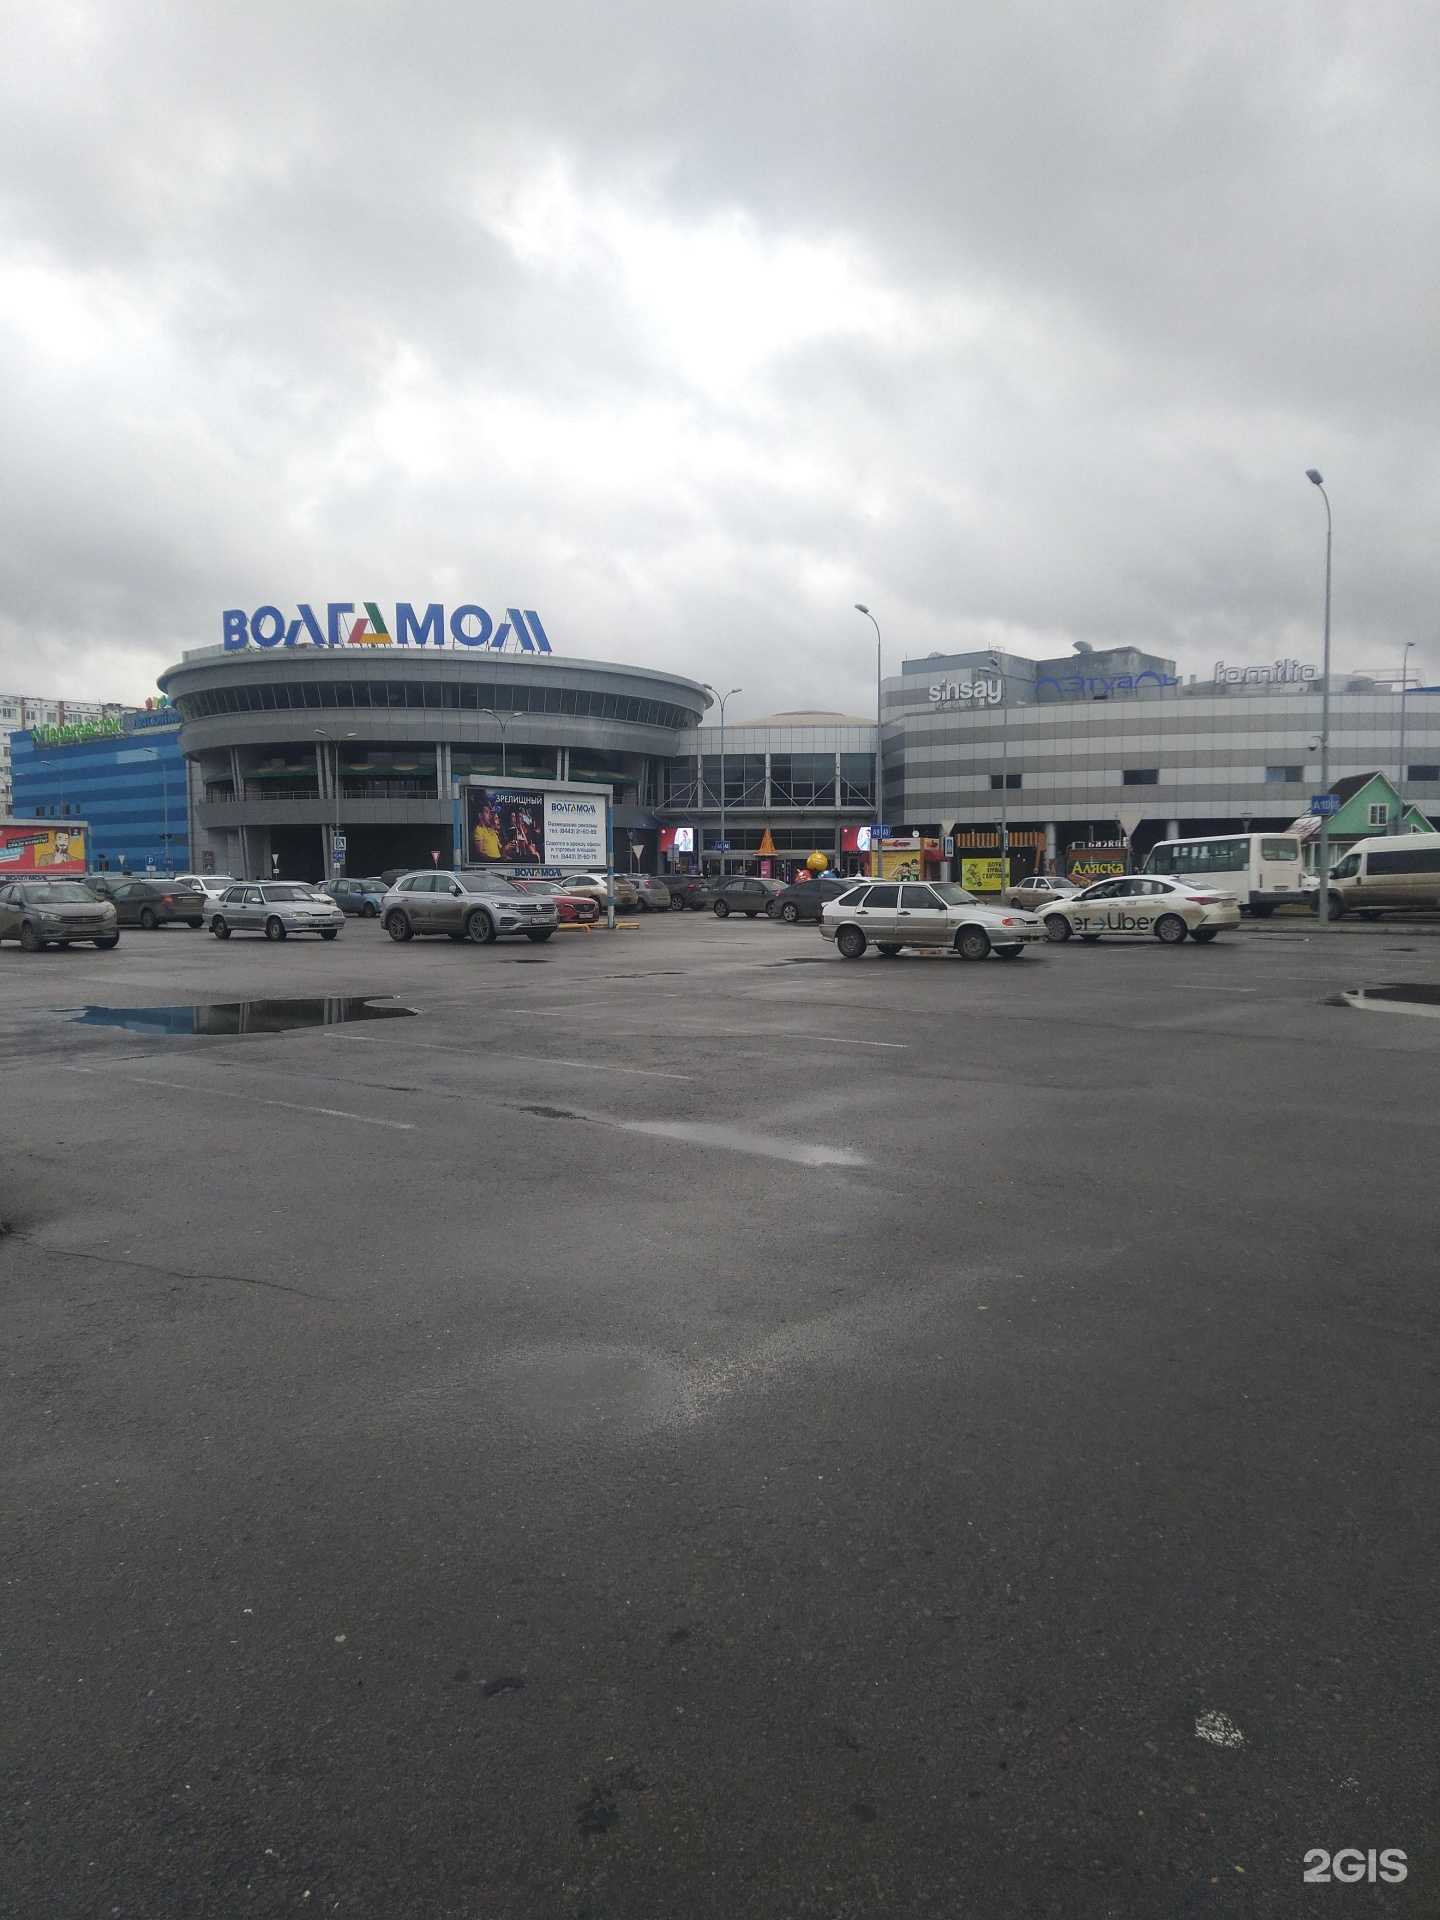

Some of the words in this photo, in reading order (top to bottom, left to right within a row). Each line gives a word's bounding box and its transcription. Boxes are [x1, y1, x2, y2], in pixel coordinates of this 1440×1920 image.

[1214, 658, 1319, 686] familia
[928, 678, 1003, 706] sinsay
[495, 793, 543, 806] ЗРЕЛИЩНЫЙ
[1072, 861, 1125, 874] Аляска
[1107, 911, 1156, 930] Uber
